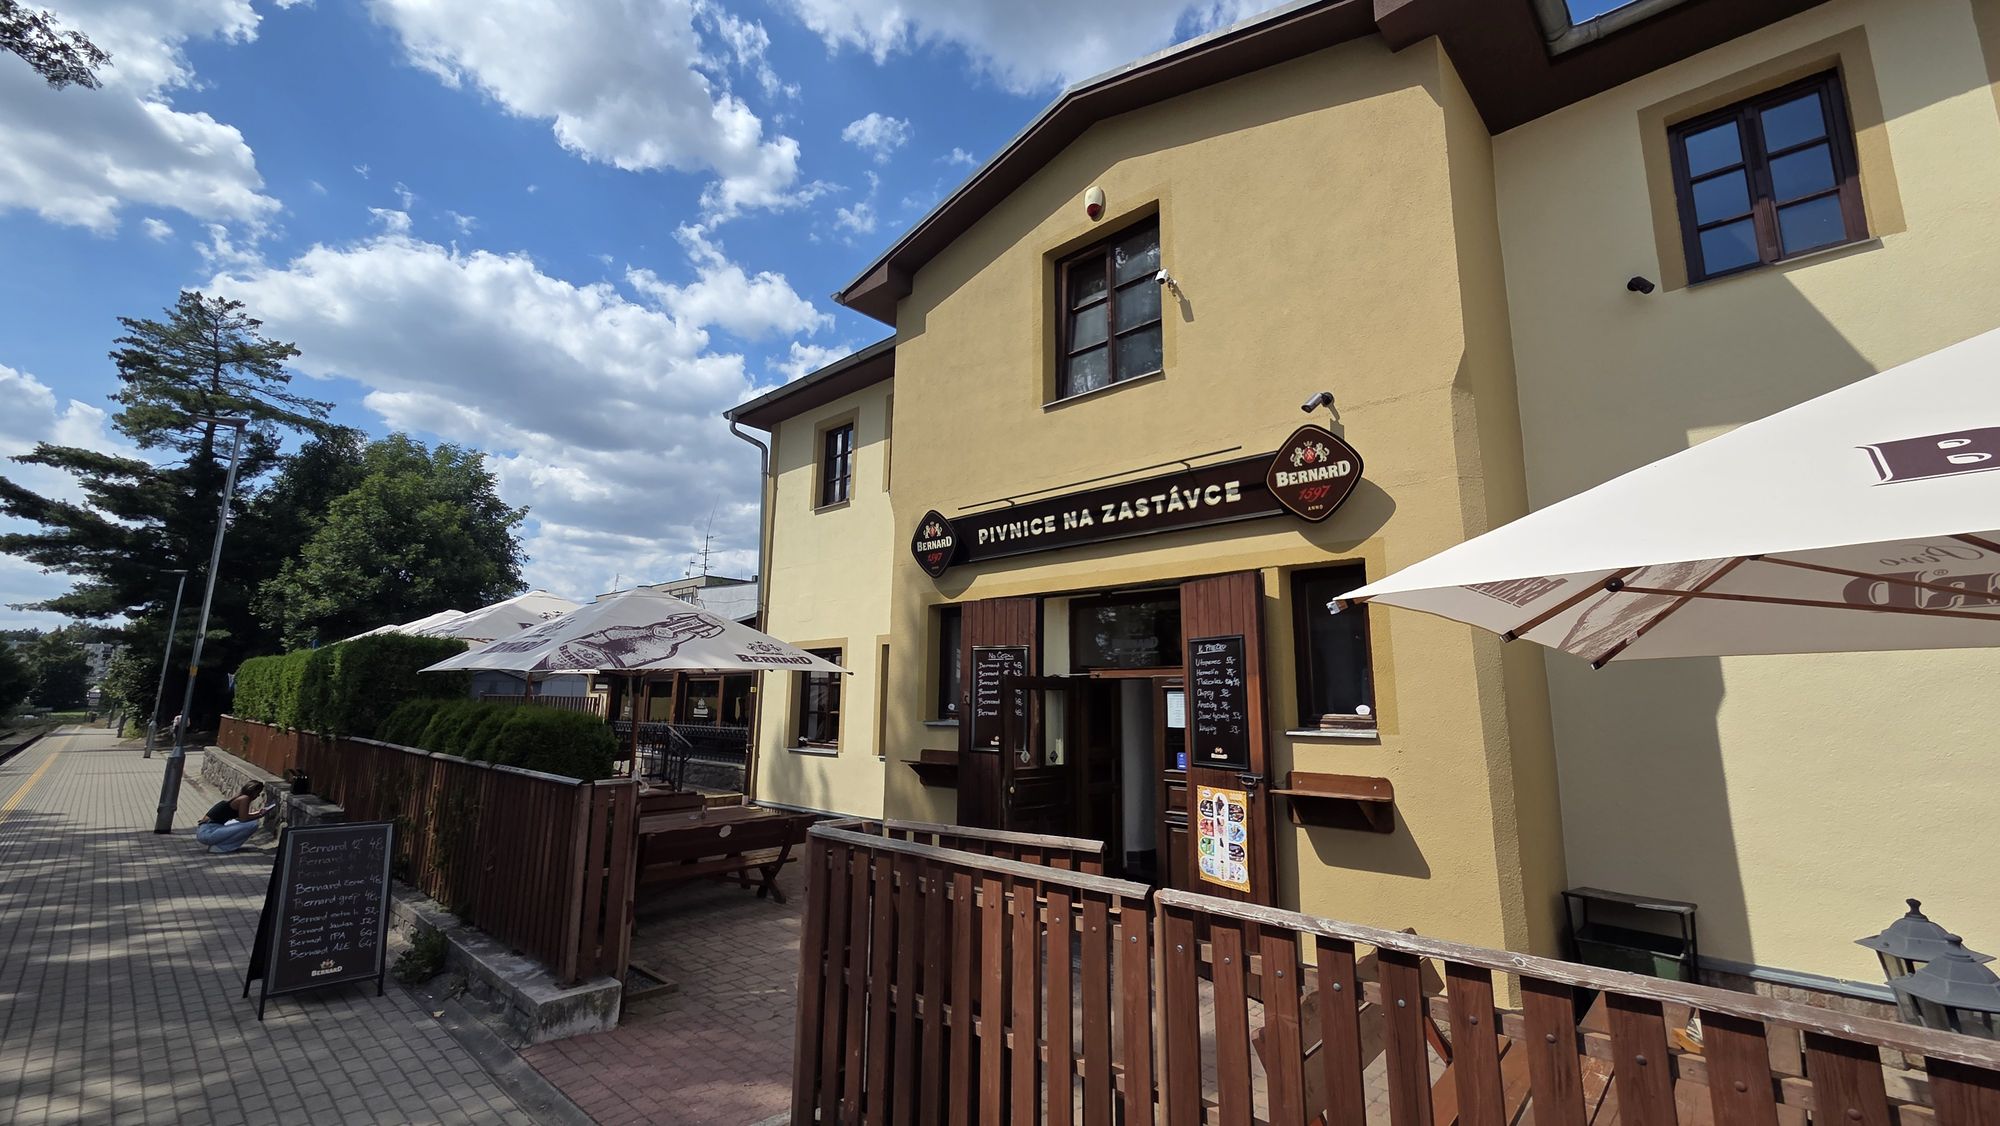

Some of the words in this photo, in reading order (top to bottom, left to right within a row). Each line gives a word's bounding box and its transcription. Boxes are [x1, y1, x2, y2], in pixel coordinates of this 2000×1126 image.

[1275, 460, 1351, 488] BERNARD
[1299, 484, 1332, 502] 1597
[978, 515, 1056, 545] PIVNICE
[1063, 509, 1095, 530] NA
[1101, 480, 1242, 524] ZASTÁVCE
[917, 536, 952, 552] BERNARD
[735, 654, 813, 665] BERNARD
[300, 841, 347, 854] Bernard
[295, 880, 341, 895] Bernard
[293, 894, 336, 908] Bernard
[290, 912, 328, 926] Bernard
[290, 926, 324, 938] Bernard
[330, 932, 346, 940] IPA
[288, 947, 329, 960] Bernard
[332, 943, 351, 952] ALE
[311, 965, 343, 977] BERNARD
